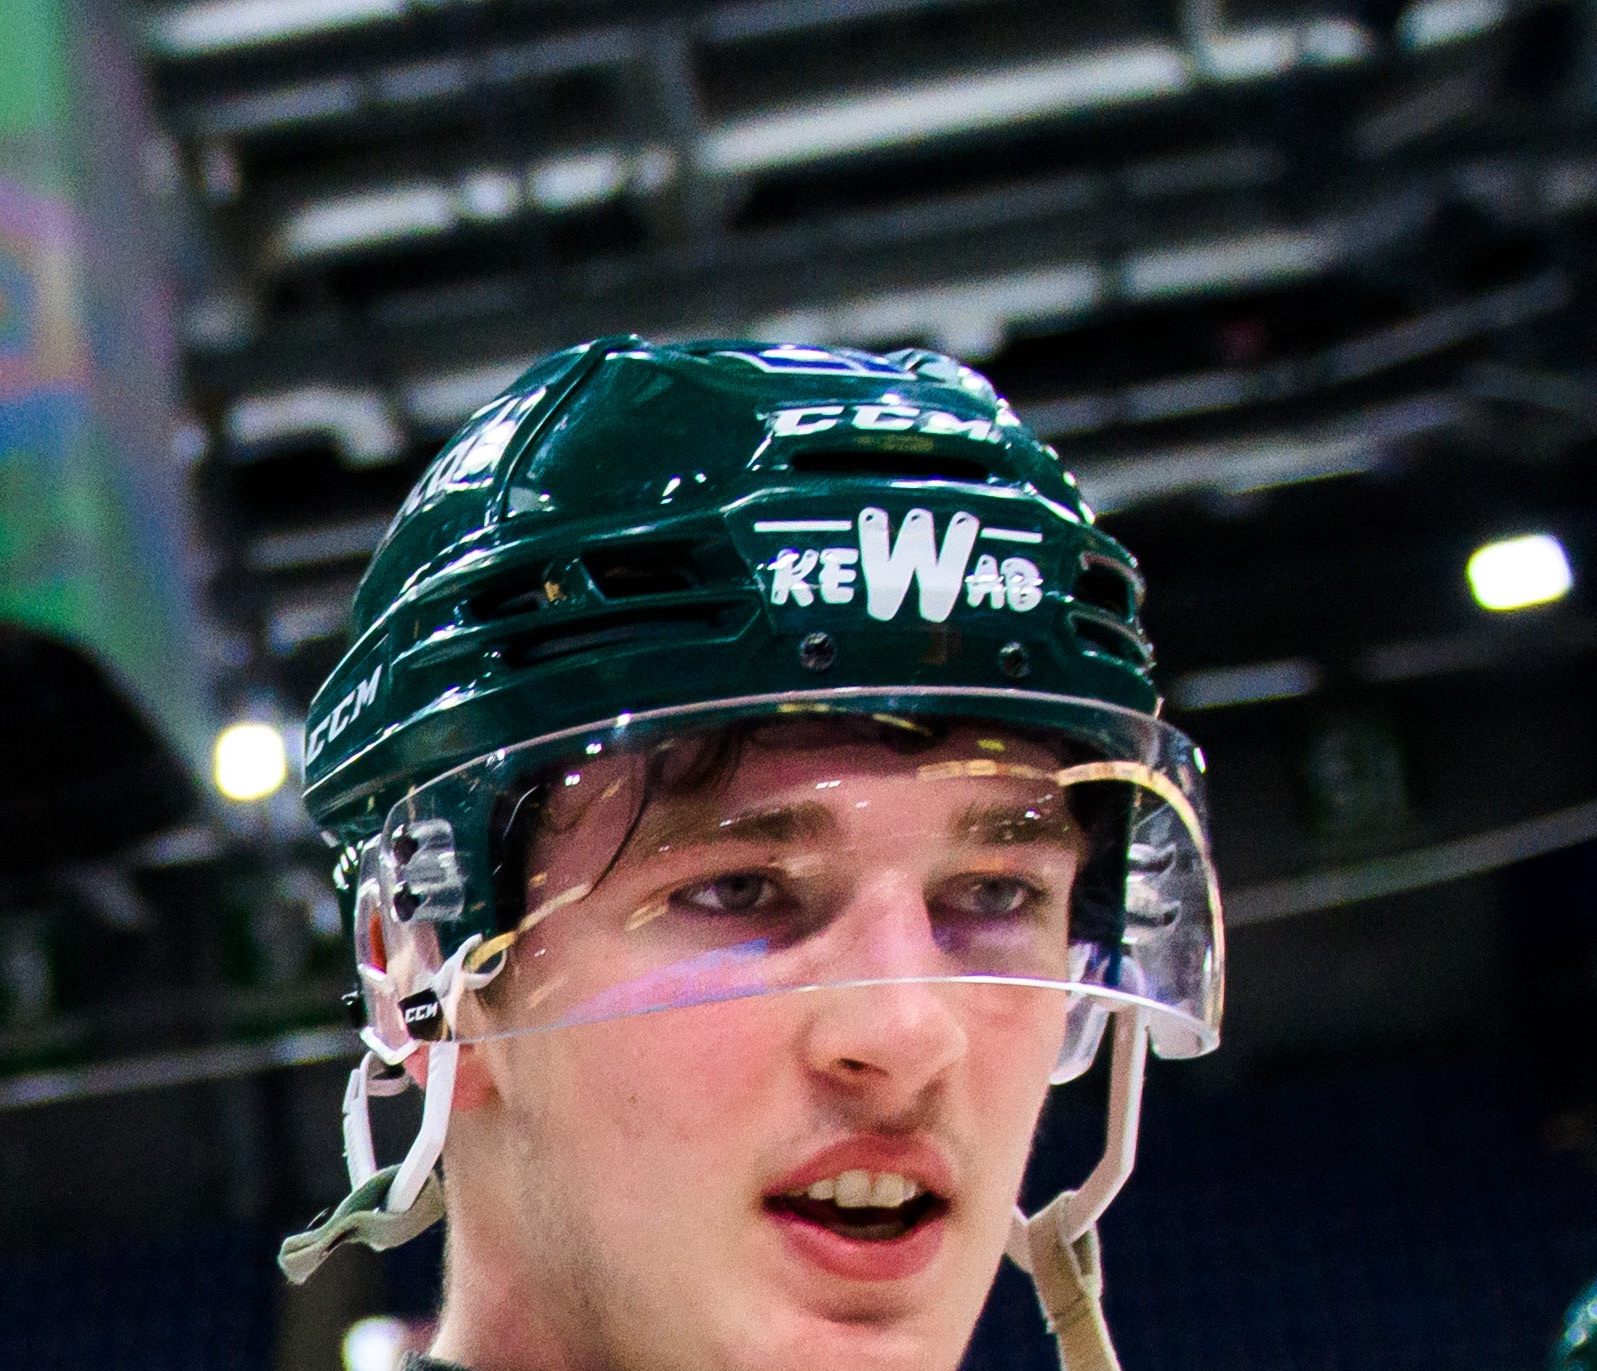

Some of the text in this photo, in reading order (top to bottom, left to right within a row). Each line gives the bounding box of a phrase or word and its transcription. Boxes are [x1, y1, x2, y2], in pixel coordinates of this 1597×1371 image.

[770, 506, 1043, 623] KEWAB
[306, 664, 382, 768] CCM
[404, 1001, 439, 1024] CCM
